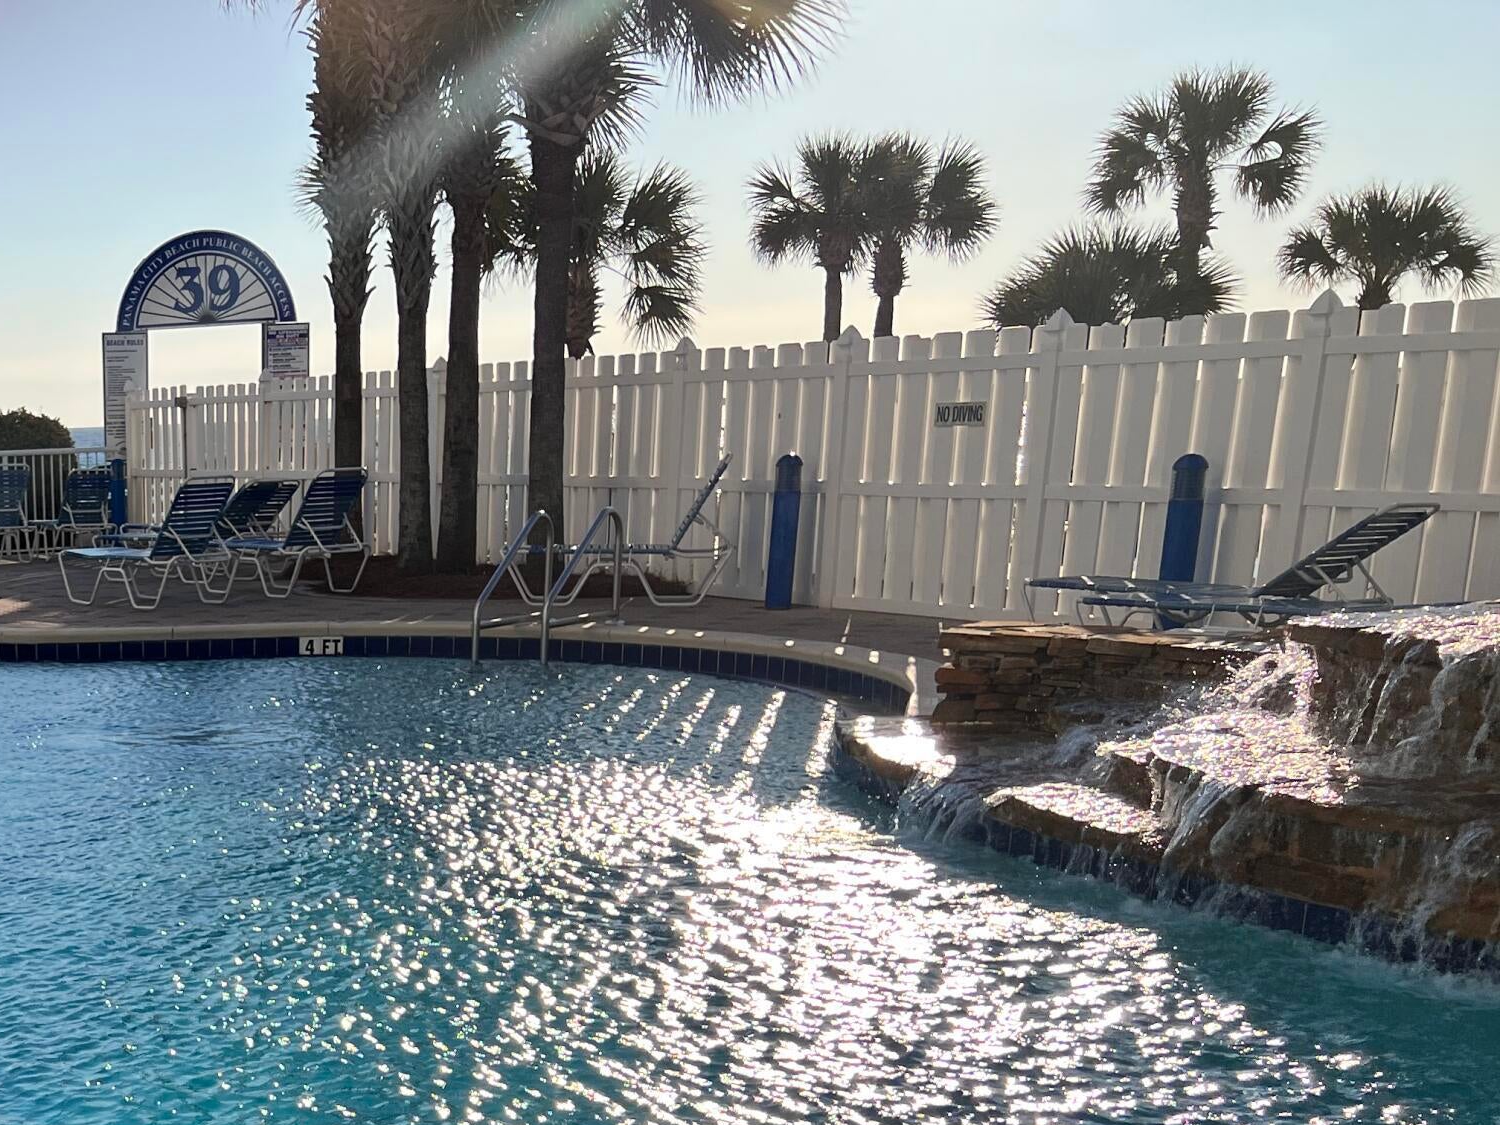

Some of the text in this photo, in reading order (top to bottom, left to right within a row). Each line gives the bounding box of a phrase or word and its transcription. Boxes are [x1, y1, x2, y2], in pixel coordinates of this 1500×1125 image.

[122, 237, 290, 326] PANAMA CITY BEACH PUBLIC BEACH ACCESS
[174, 264, 240, 313] 39
[936, 405, 983, 422] NO DIVING
[305, 639, 314, 656] 4
